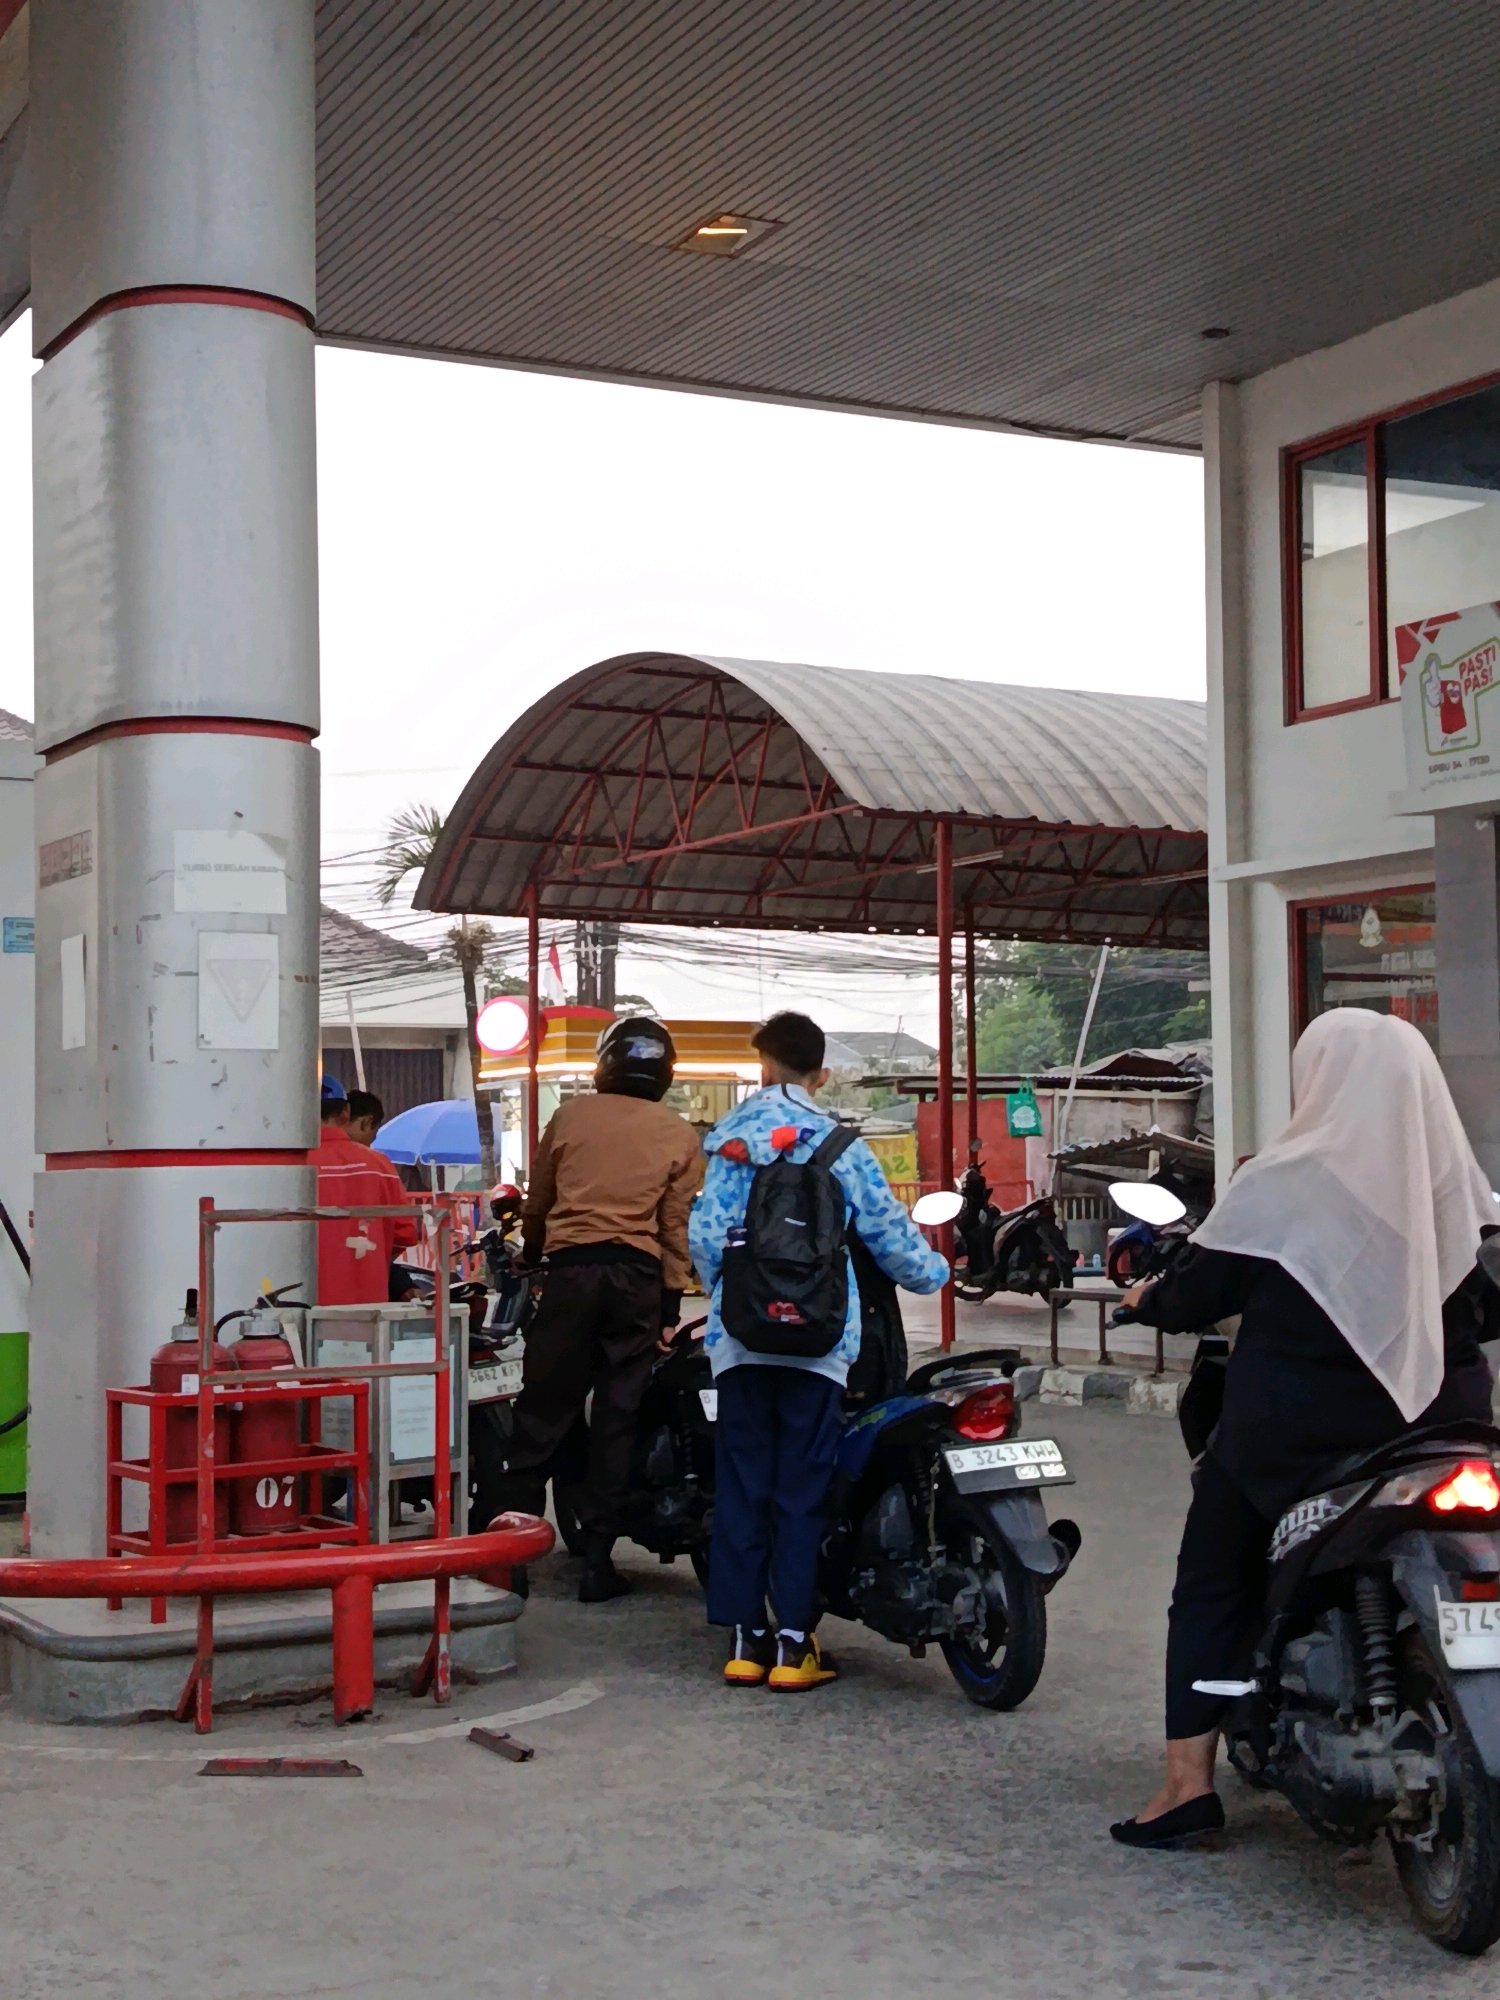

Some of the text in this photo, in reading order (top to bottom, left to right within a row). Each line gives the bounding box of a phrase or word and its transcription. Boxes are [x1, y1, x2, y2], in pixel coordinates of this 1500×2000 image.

[1458, 644, 1497, 680] PASTI
[1463, 665, 1494, 696] PAS!
[469, 1367, 498, 1384] 5662
[950, 1453, 965, 1469] B
[971, 1446, 1019, 1466] 3243
[255, 1475, 295, 1509] 07
